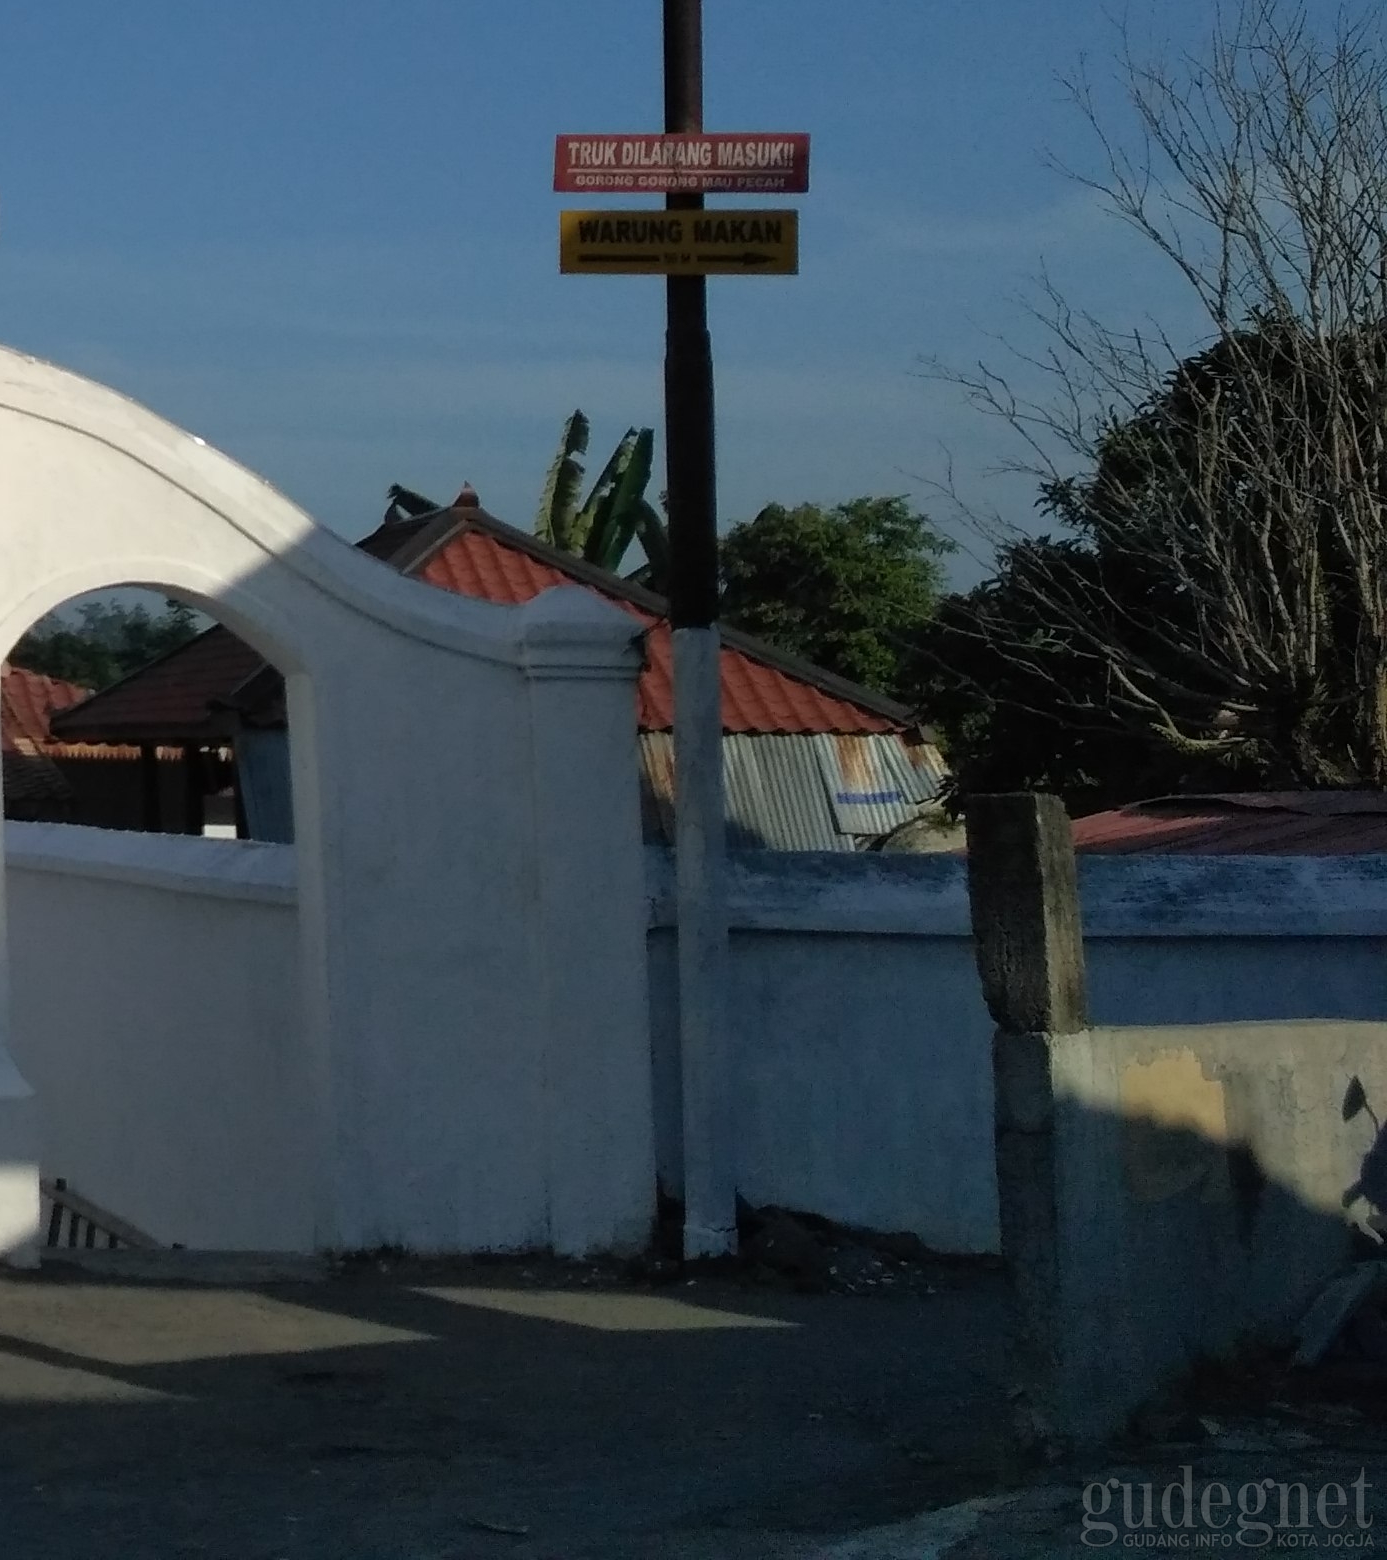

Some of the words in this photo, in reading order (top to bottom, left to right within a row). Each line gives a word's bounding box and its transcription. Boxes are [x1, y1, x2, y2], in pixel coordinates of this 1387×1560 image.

[568, 141, 617, 165] TRUK
[622, 142, 712, 167] DILARANG
[718, 142, 795, 167] MASUK!!
[576, 175, 631, 188] GORONG
[638, 175, 698, 188] GORONG
[702, 176, 732, 188] MAU
[737, 176, 785, 188] PECAH
[578, 219, 682, 244] WARUNG
[693, 219, 782, 244] MAKAN
